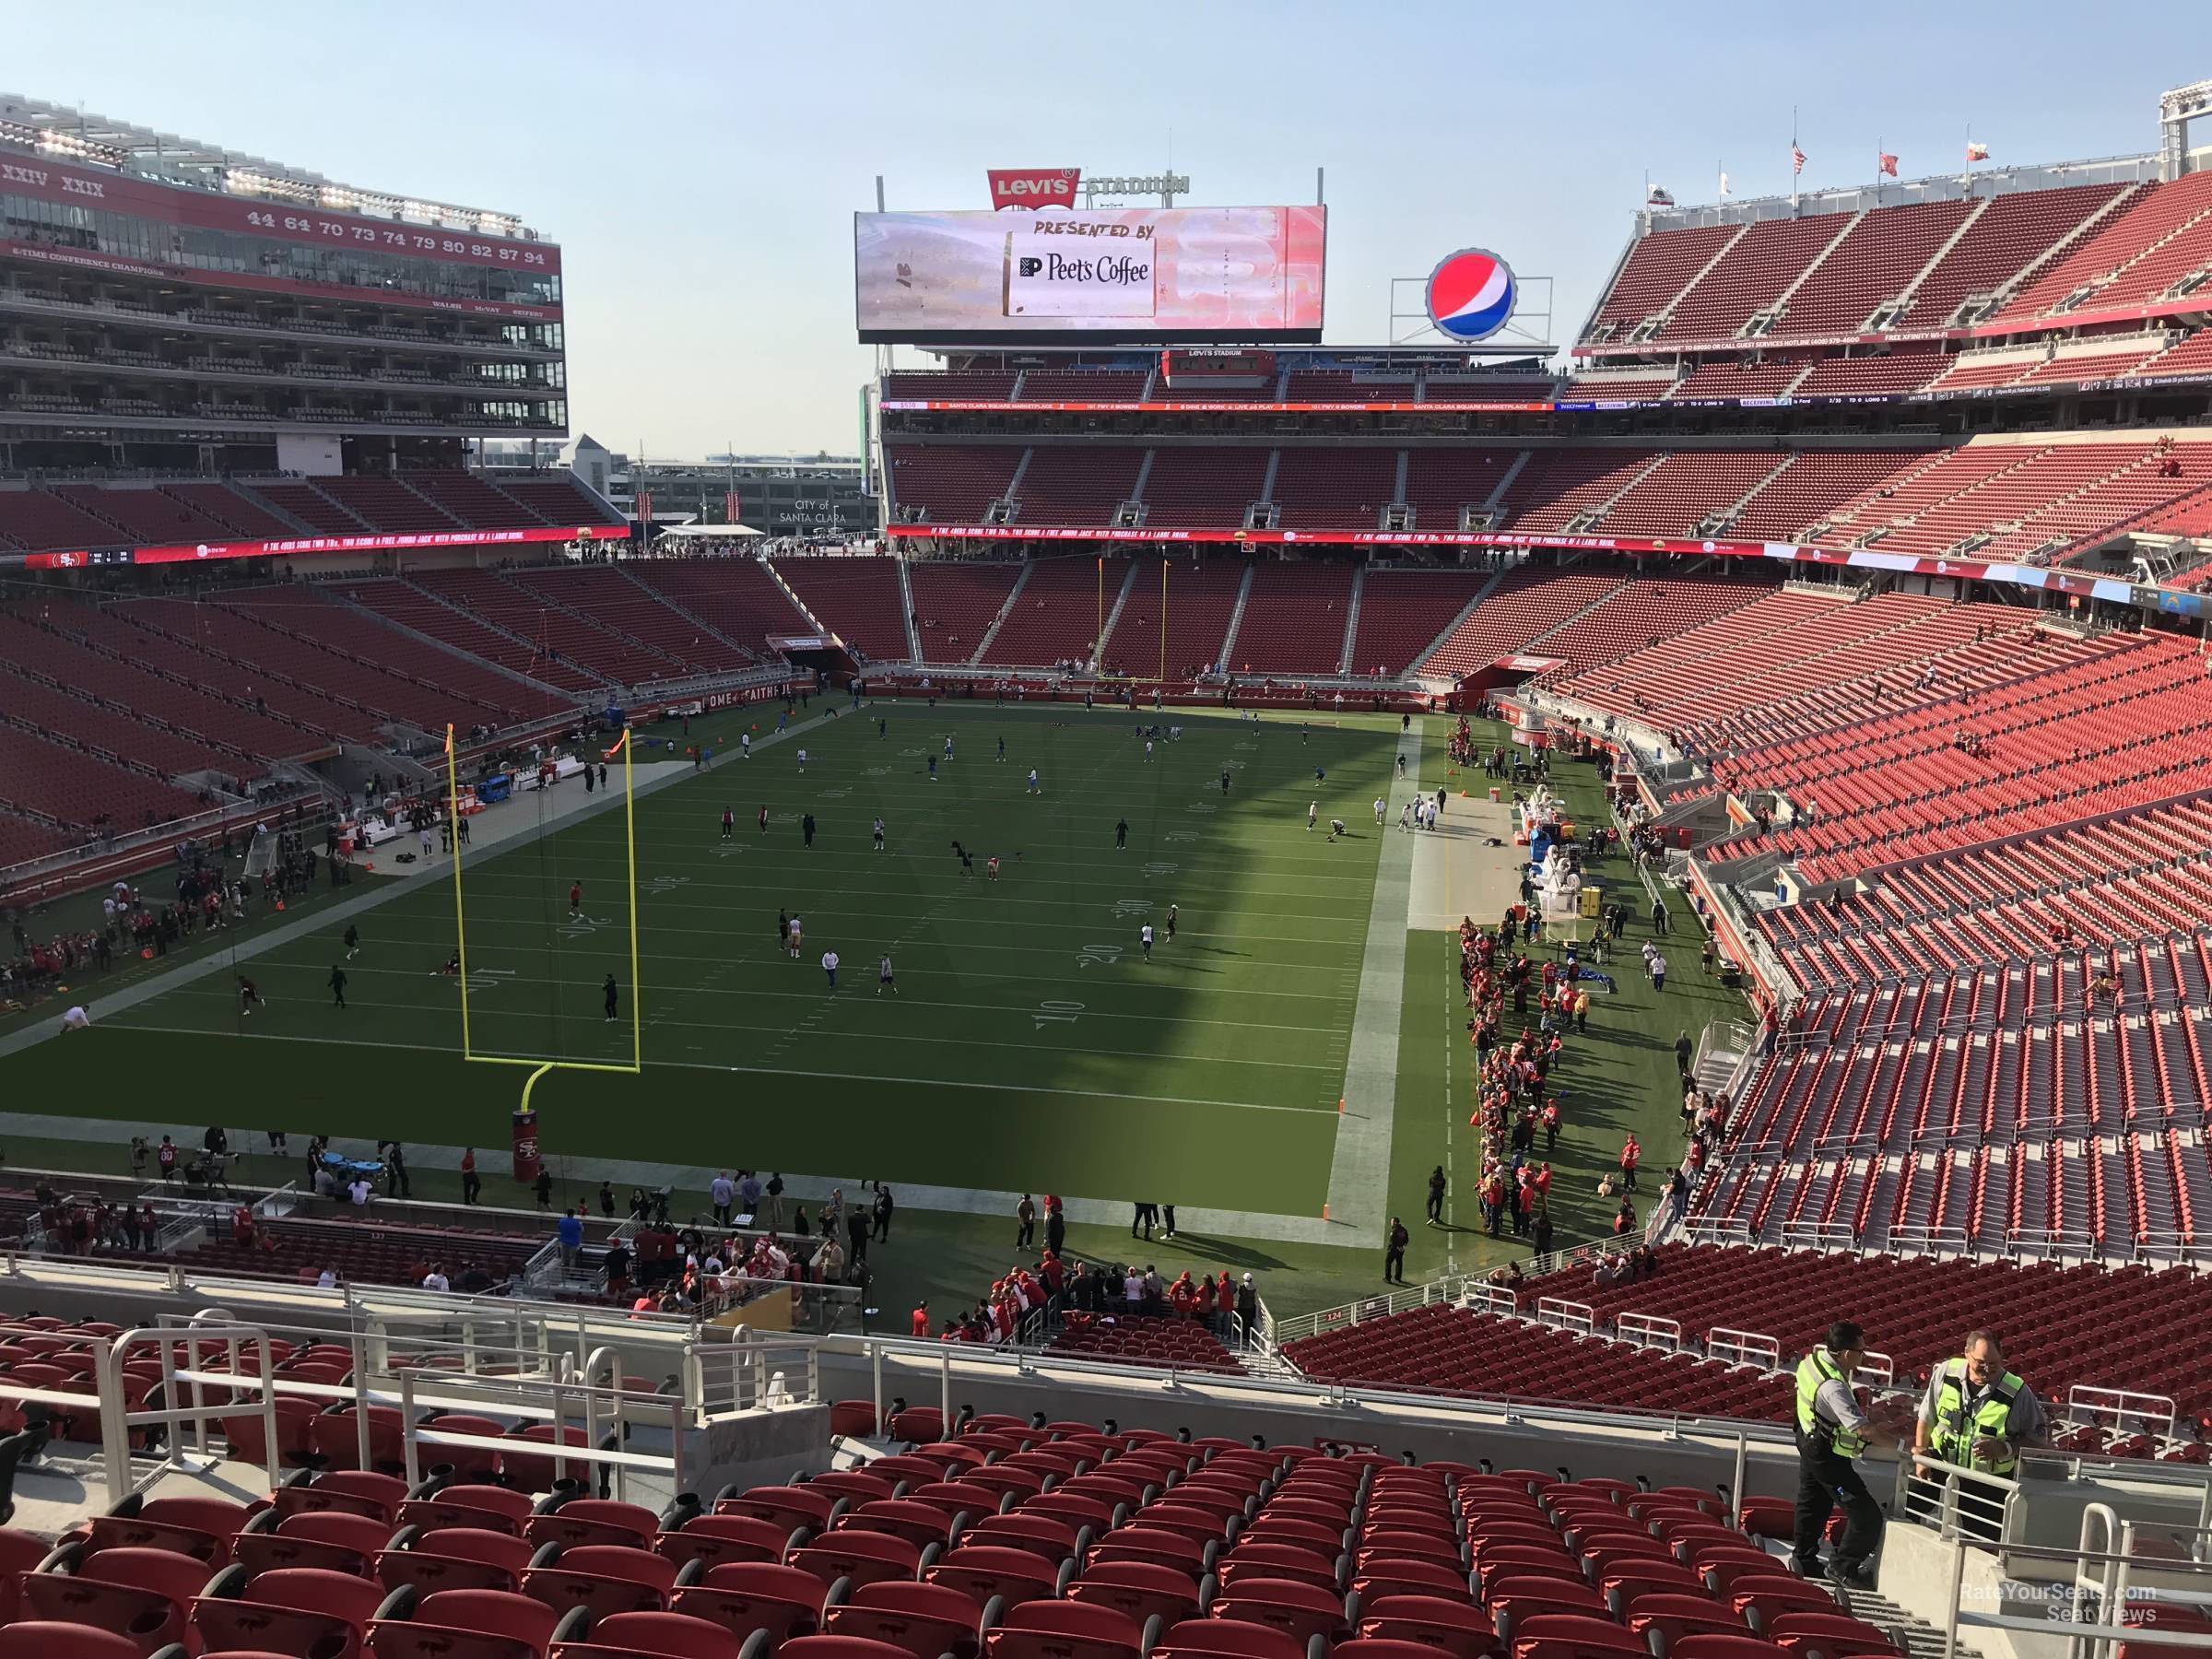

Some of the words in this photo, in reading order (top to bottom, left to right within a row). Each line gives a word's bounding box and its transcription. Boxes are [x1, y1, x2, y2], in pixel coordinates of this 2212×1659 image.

[1, 163, 48, 187] XXIV
[61, 176, 105, 198] XXIX
[1085, 176, 1190, 195] STADIUM
[247, 211, 275, 228] 44
[284, 217, 311, 232] 64
[319, 221, 344, 236] 70
[351, 227, 376, 241] 73
[382, 231, 406, 246] 74
[413, 236, 436, 249] 79
[442, 241, 465, 253] 80
[471, 244, 492, 258] 82
[499, 248, 518, 262] 87
[524, 252, 545, 265] 94
[1034, 220, 1129, 238] PRESENTED
[1135, 225, 1155, 241] BY
[49, 253, 111, 268] CONFERENCE
[112, 263, 164, 276] CHAMPIONS
[1047, 253, 1092, 282] Peet's
[1097, 256, 1148, 286] Coffee
[432, 301, 463, 310] WALSH
[512, 310, 544, 318] SEIFERT
[795, 500, 816, 510] CITY
[819, 500, 830, 510] of
[780, 513, 811, 523] SANTA
[816, 513, 846, 524] CLARA
[270, 542, 279, 550] THE
[296, 540, 311, 549] SCORE
[312, 539, 324, 548] TWO
[375, 536, 380, 545] A
[381, 536, 395, 545] FREE
[396, 535, 417, 544] JUMBO
[435, 535, 450, 543] WITH
[451, 534, 477, 542] PURCHASE
[640, 876, 690, 889] 30
[1111, 900, 1154, 914] 30
[1076, 945, 1124, 963] 20
[1031, 1001, 1086, 1023] 10
[1577, 1248, 1588, 1256] 123
[1327, 1312, 1342, 1321] 124
